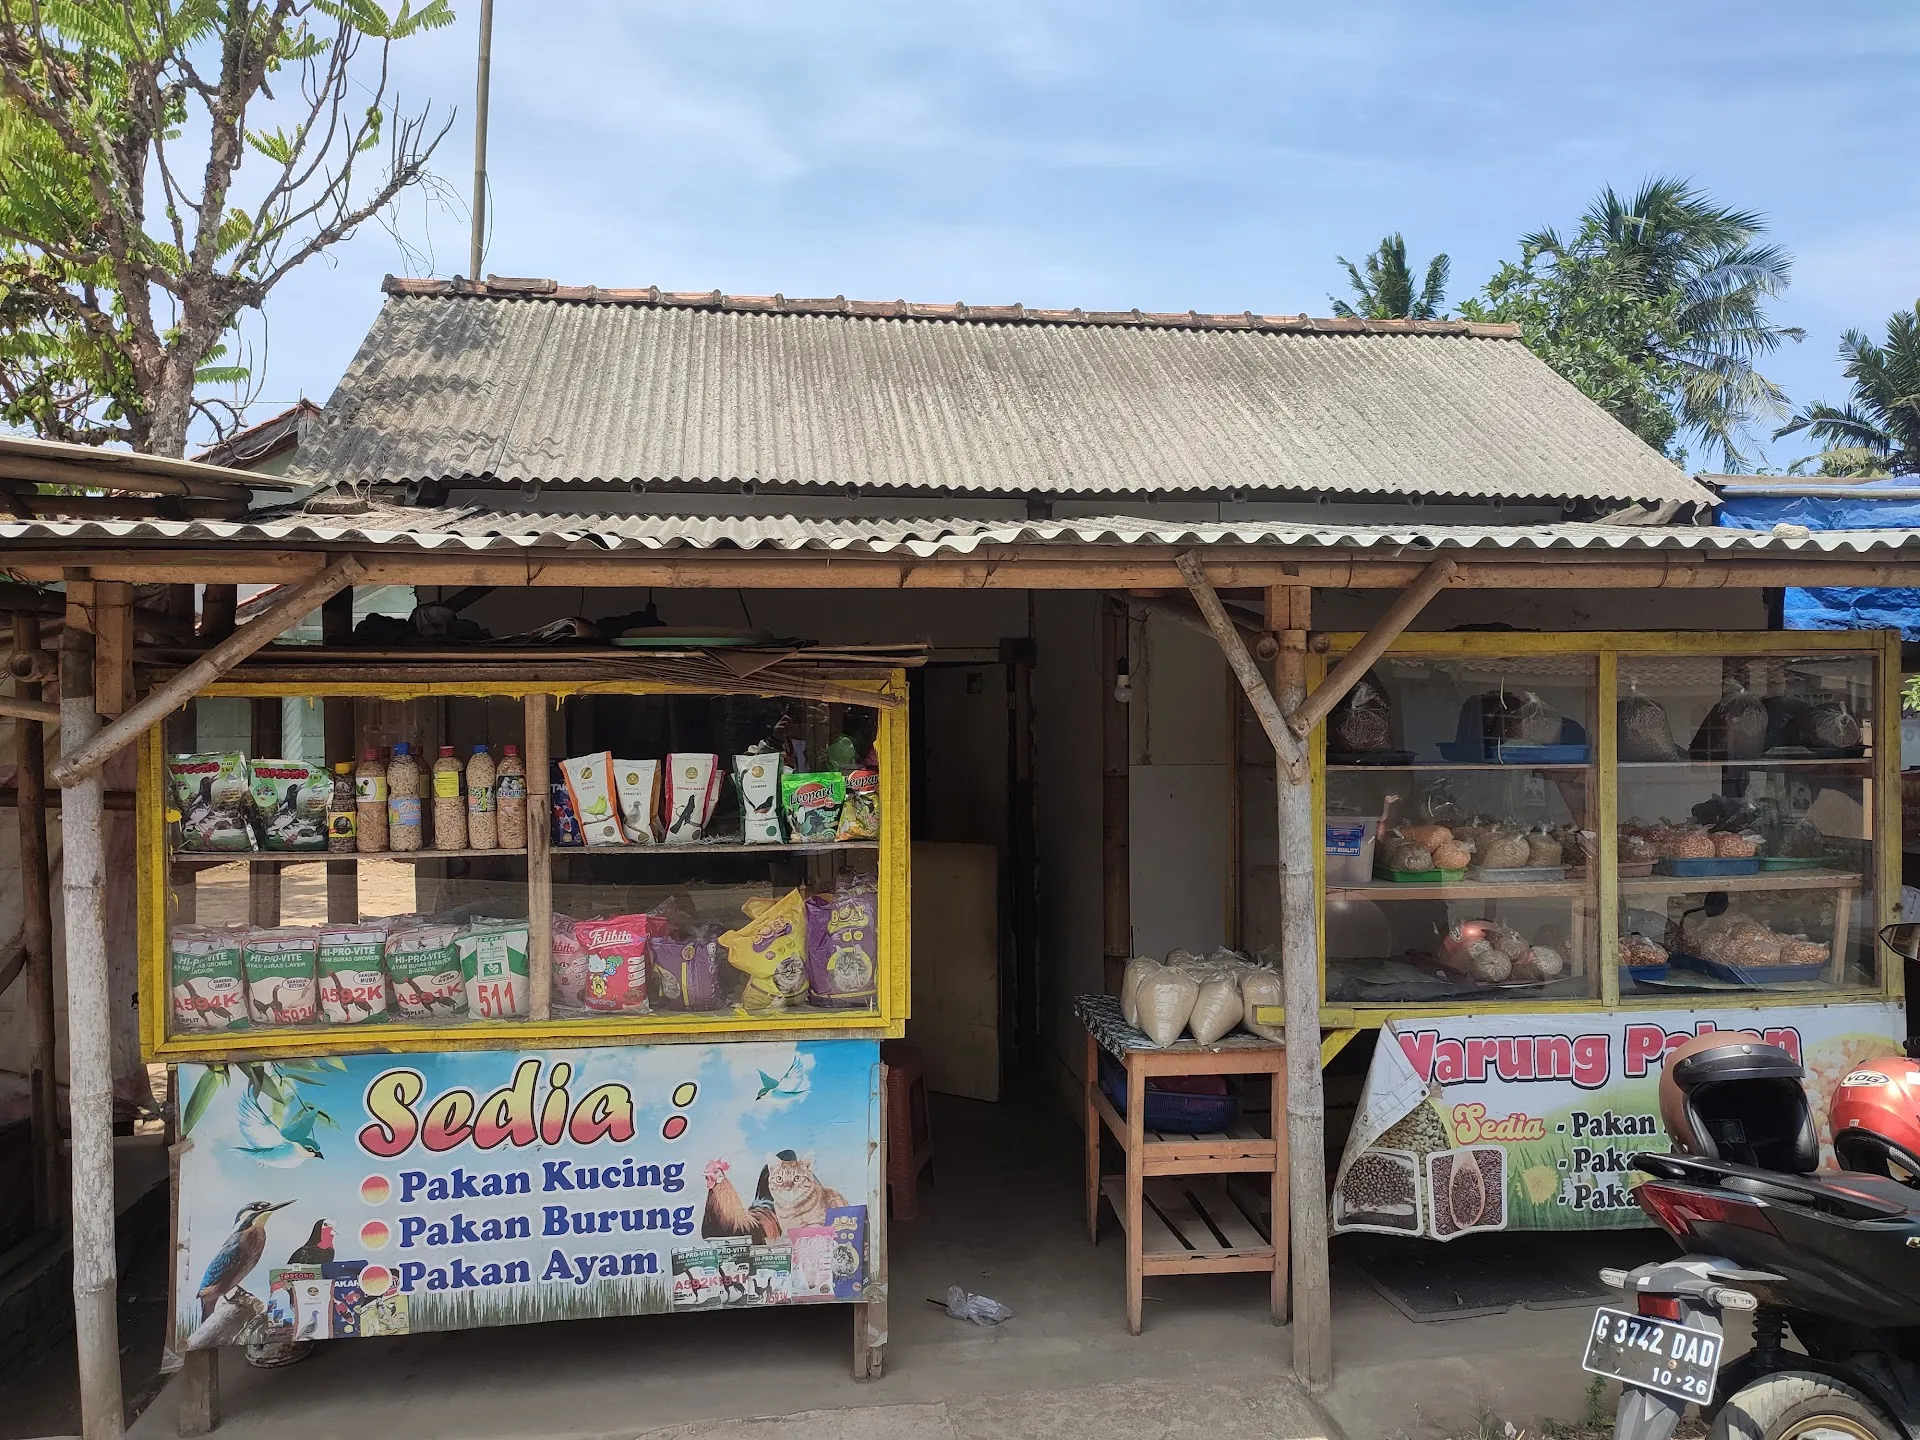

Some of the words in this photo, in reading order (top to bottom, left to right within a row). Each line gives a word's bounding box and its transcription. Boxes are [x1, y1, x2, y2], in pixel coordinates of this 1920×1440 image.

[845, 774, 879, 789] Leopar
[789, 783, 835, 806] Leopard
[321, 945, 376, 956] HI-PRO-VITE
[588, 928, 634, 950] Felibite
[395, 950, 447, 964] HI-PRO-VITE
[174, 991, 240, 1013] A594K
[321, 984, 384, 1004] A592K
[477, 981, 517, 1018] 511
[358, 1059, 636, 1158] Sedia
[1452, 1102, 1547, 1145] Sedia
[1571, 1111, 1656, 1138] Pakan
[1573, 1147, 1636, 1173] Paka
[399, 1168, 532, 1203] Pakan
[542, 1158, 685, 1193] Kucing
[1573, 1184, 1641, 1209] Paka
[399, 1213, 532, 1248] Pakan
[542, 1205, 695, 1236] Burung
[399, 1258, 531, 1292] Pakan
[541, 1249, 658, 1285] Ayam
[674, 1278, 719, 1291] A592K
[1613, 1319, 1665, 1356] 3742
[1671, 1332, 1716, 1368] DAD
